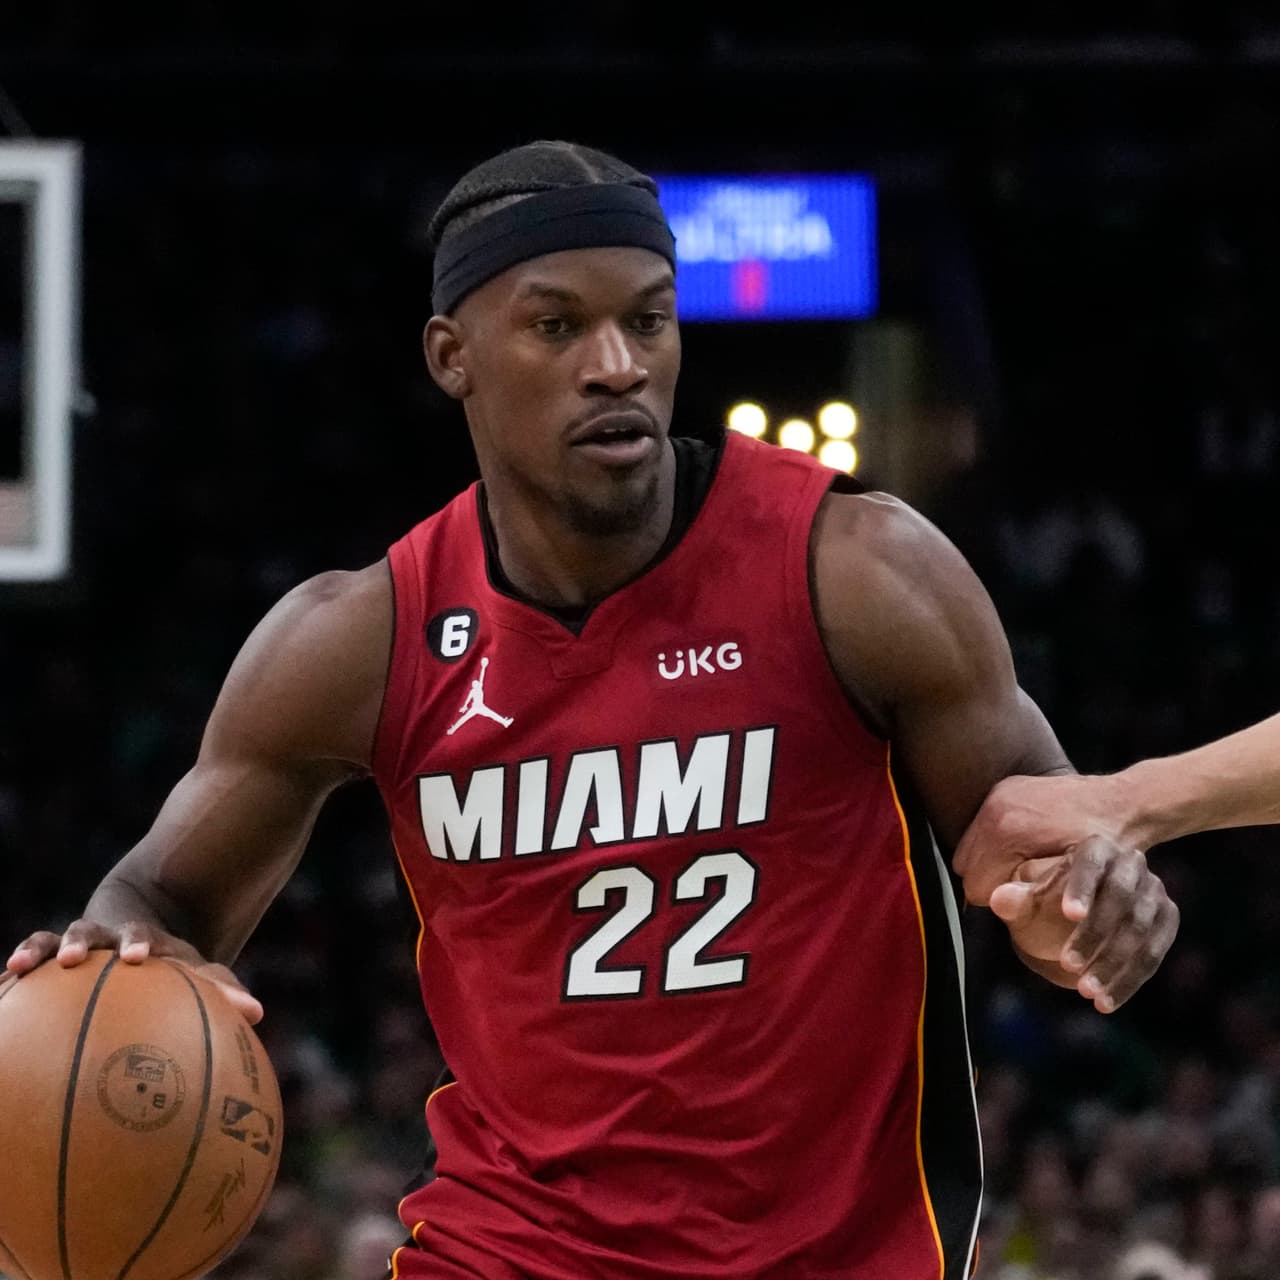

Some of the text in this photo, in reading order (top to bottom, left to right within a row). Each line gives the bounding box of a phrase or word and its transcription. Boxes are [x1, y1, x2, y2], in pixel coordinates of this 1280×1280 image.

[439, 614, 472, 658] 6
[418, 726, 776, 861] MIAMI
[563, 851, 758, 1000] 22
